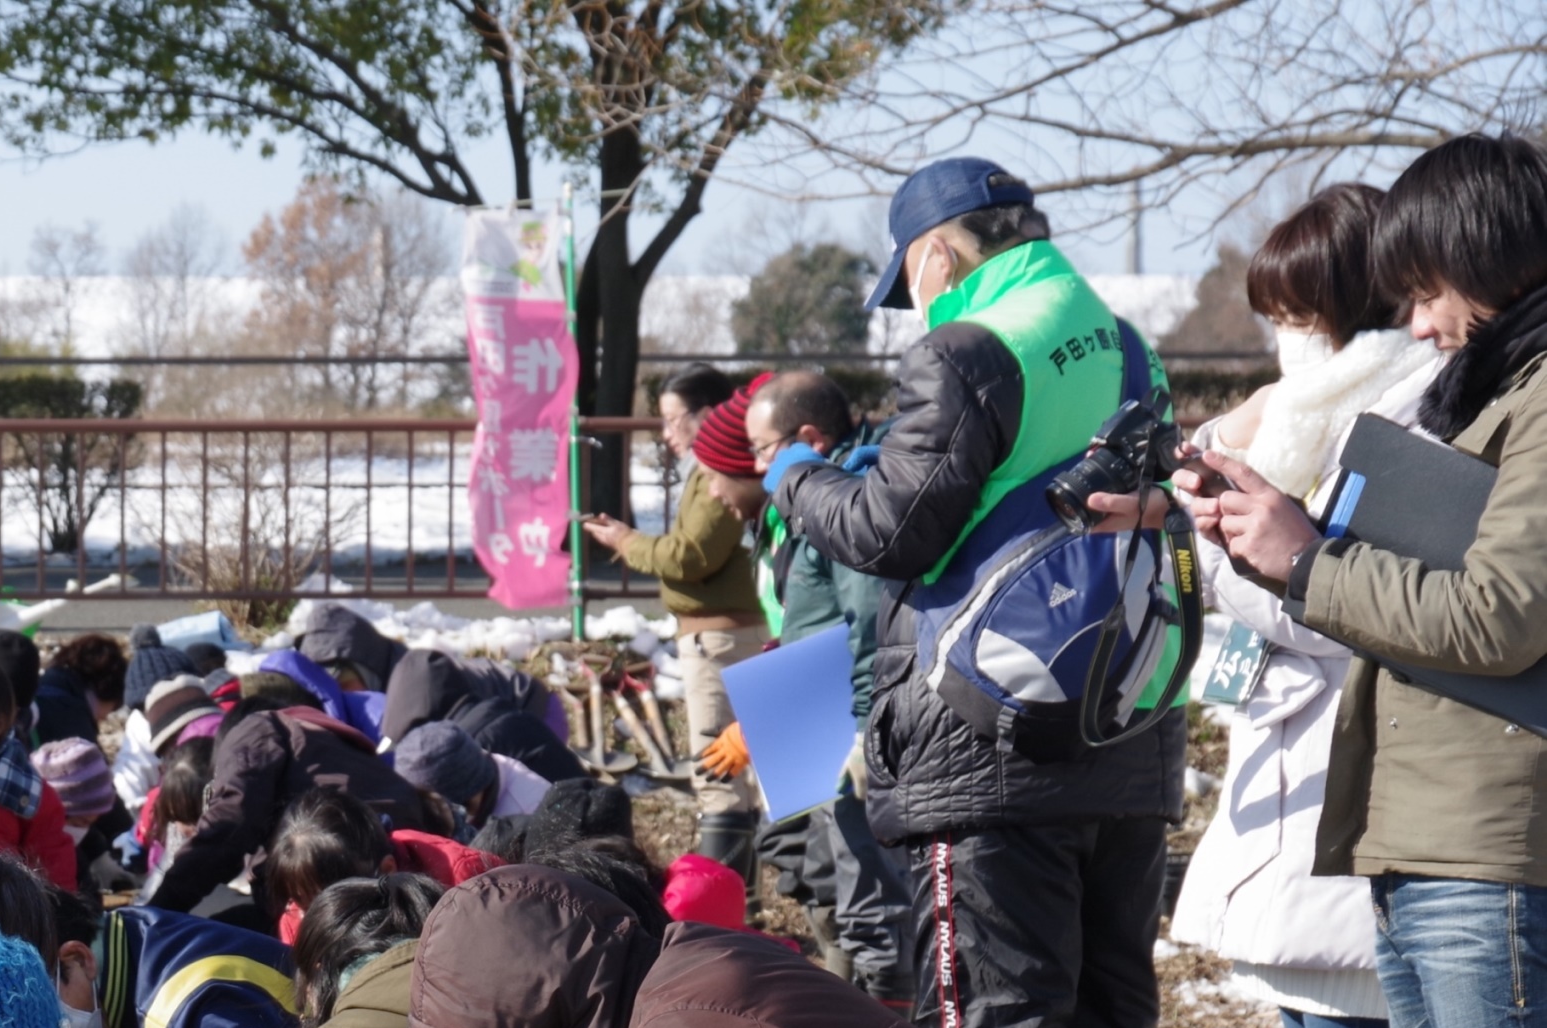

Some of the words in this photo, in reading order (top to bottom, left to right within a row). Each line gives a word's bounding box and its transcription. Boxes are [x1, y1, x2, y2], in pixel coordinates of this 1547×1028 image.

[1049, 588, 1077, 607] adidas
[1176, 549, 1193, 593] Nikon
[936, 842, 948, 908] NYLAUS
[939, 921, 952, 987] NYLAUS
